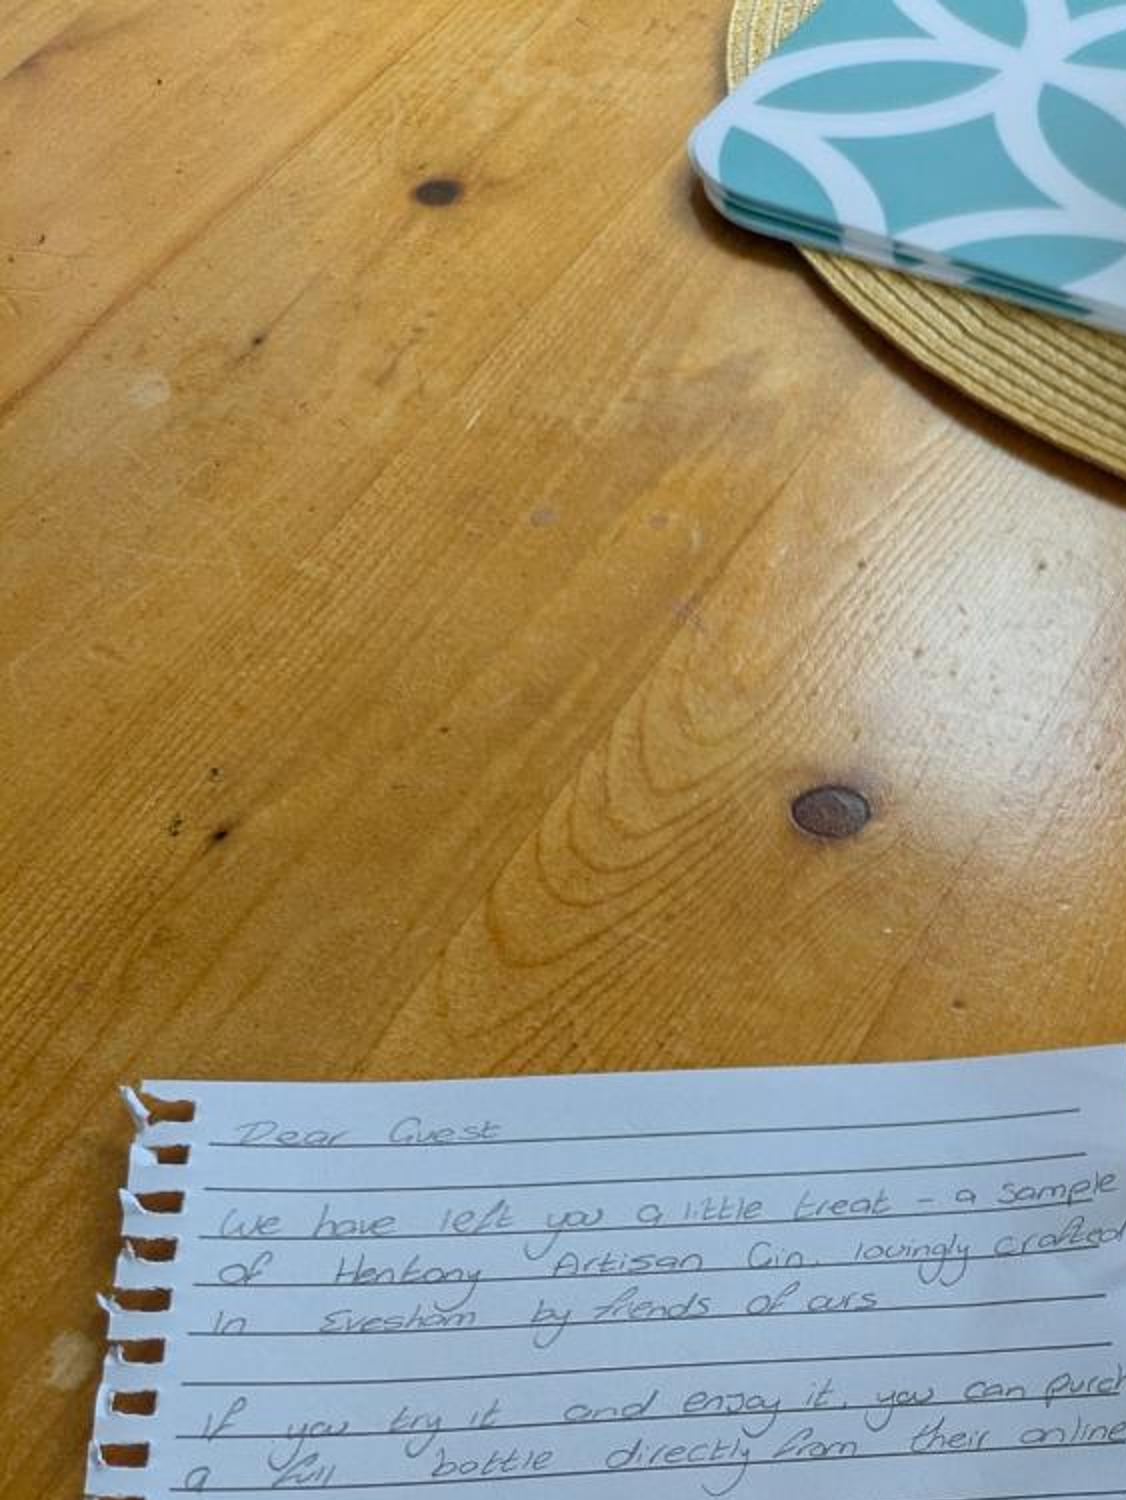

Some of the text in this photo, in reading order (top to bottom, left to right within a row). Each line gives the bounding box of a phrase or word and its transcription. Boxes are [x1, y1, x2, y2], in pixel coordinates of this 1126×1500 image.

[240, 1117, 502, 1146] Dear Guest
[218, 1208, 283, 1236] We
[312, 1205, 399, 1236] have
[439, 1200, 514, 1233] left
[523, 1208, 605, 1259] you
[637, 1204, 664, 1221] a
[683, 1198, 764, 1220] little
[793, 1191, 893, 1218] treat
[955, 1188, 977, 1204] a
[1001, 1171, 1119, 1207] sample
[217, 1251, 274, 1284] of
[333, 1254, 483, 1312] Hentony
[552, 1251, 704, 1277] Artisan
[854, 1233, 971, 1286] lovingly
[318, 1308, 478, 1334] Evesham
[530, 1298, 572, 1349] by
[746, 1281, 801, 1315] of
[807, 1291, 878, 1312] ours
[183, 1465, 211, 1492] a
[270, 1451, 335, 1490] full
[431, 1448, 554, 1479] bottle
[605, 1435, 751, 1496] directly
[772, 1427, 860, 1460] from
[910, 1417, 992, 1453] their
[267, 1419, 349, 1471] you
[387, 1406, 441, 1459] try
[468, 1399, 501, 1428] it
[562, 1390, 658, 1421] and
[864, 1387, 935, 1432] you
[963, 1380, 1026, 1402] can
